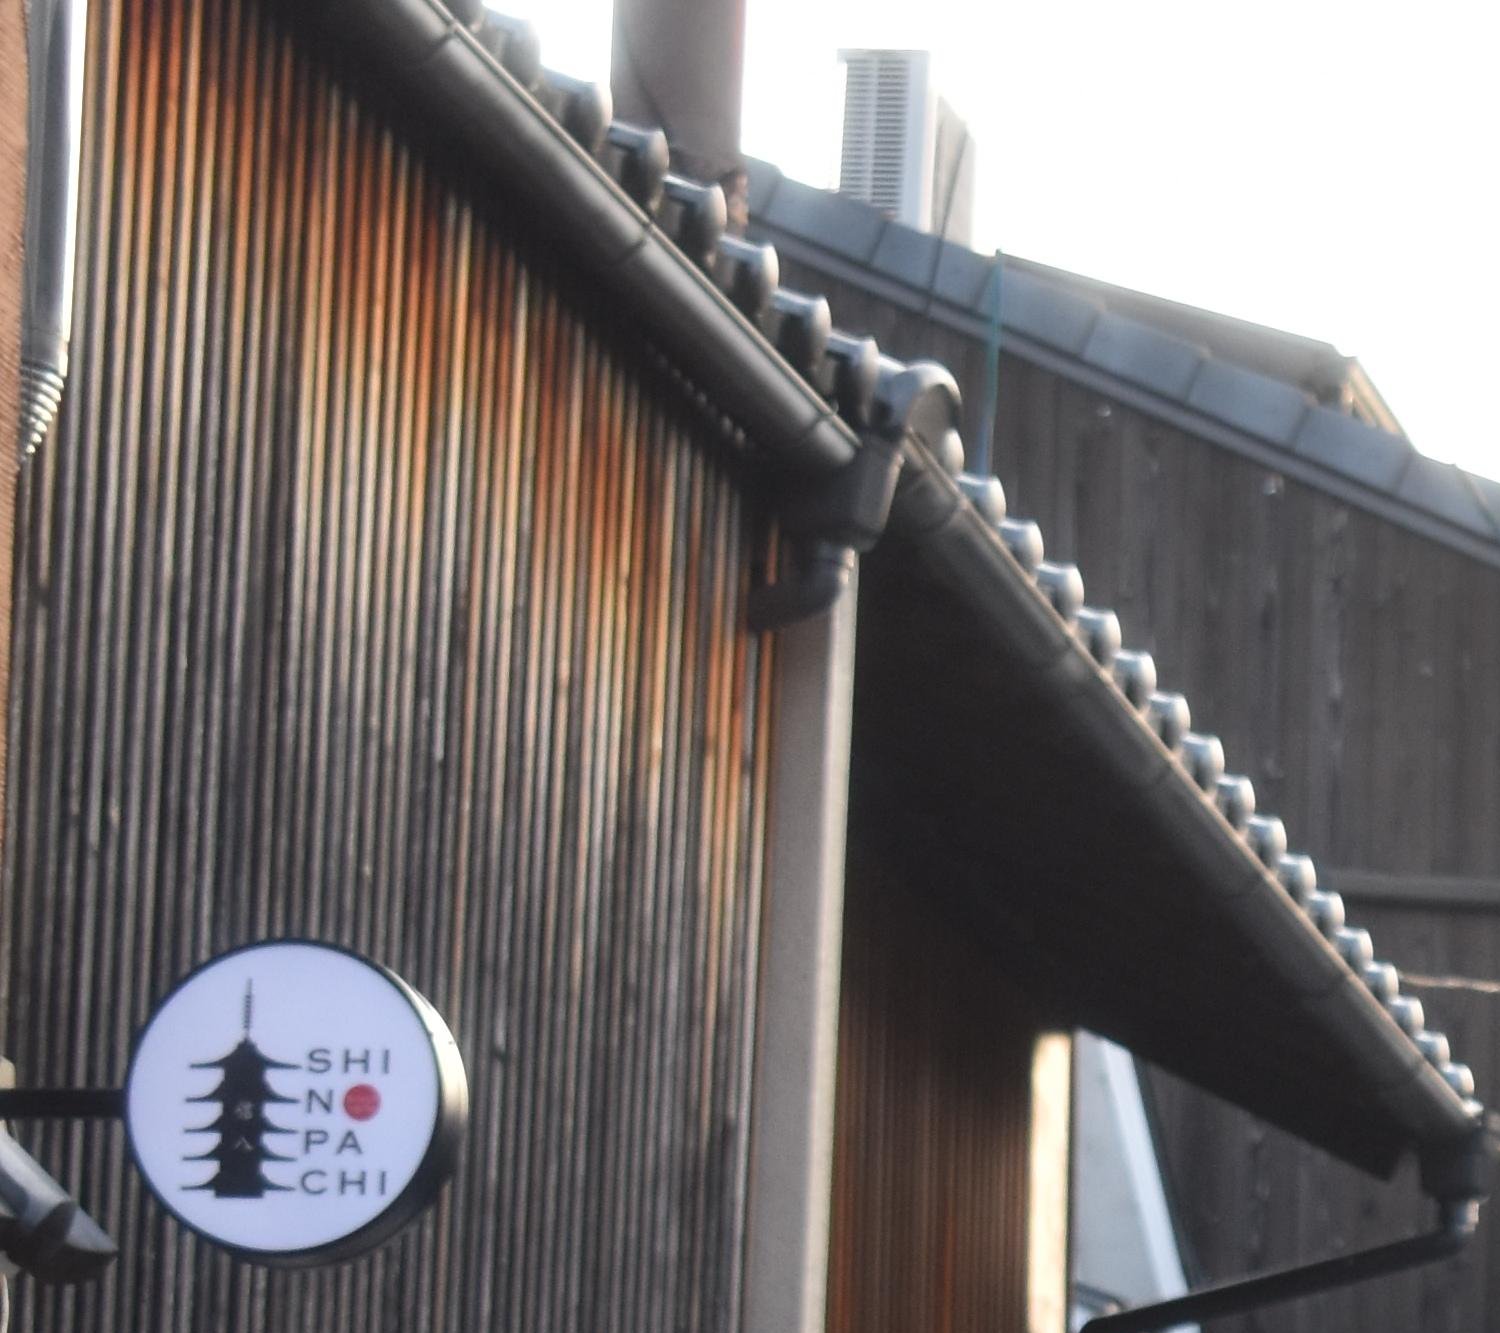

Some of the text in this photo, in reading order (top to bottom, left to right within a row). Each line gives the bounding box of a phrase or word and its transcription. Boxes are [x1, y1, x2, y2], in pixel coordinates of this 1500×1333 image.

[306, 1048, 391, 1074] SHI
[303, 1130, 364, 1157] PA
[299, 1170, 388, 1197] CHI
